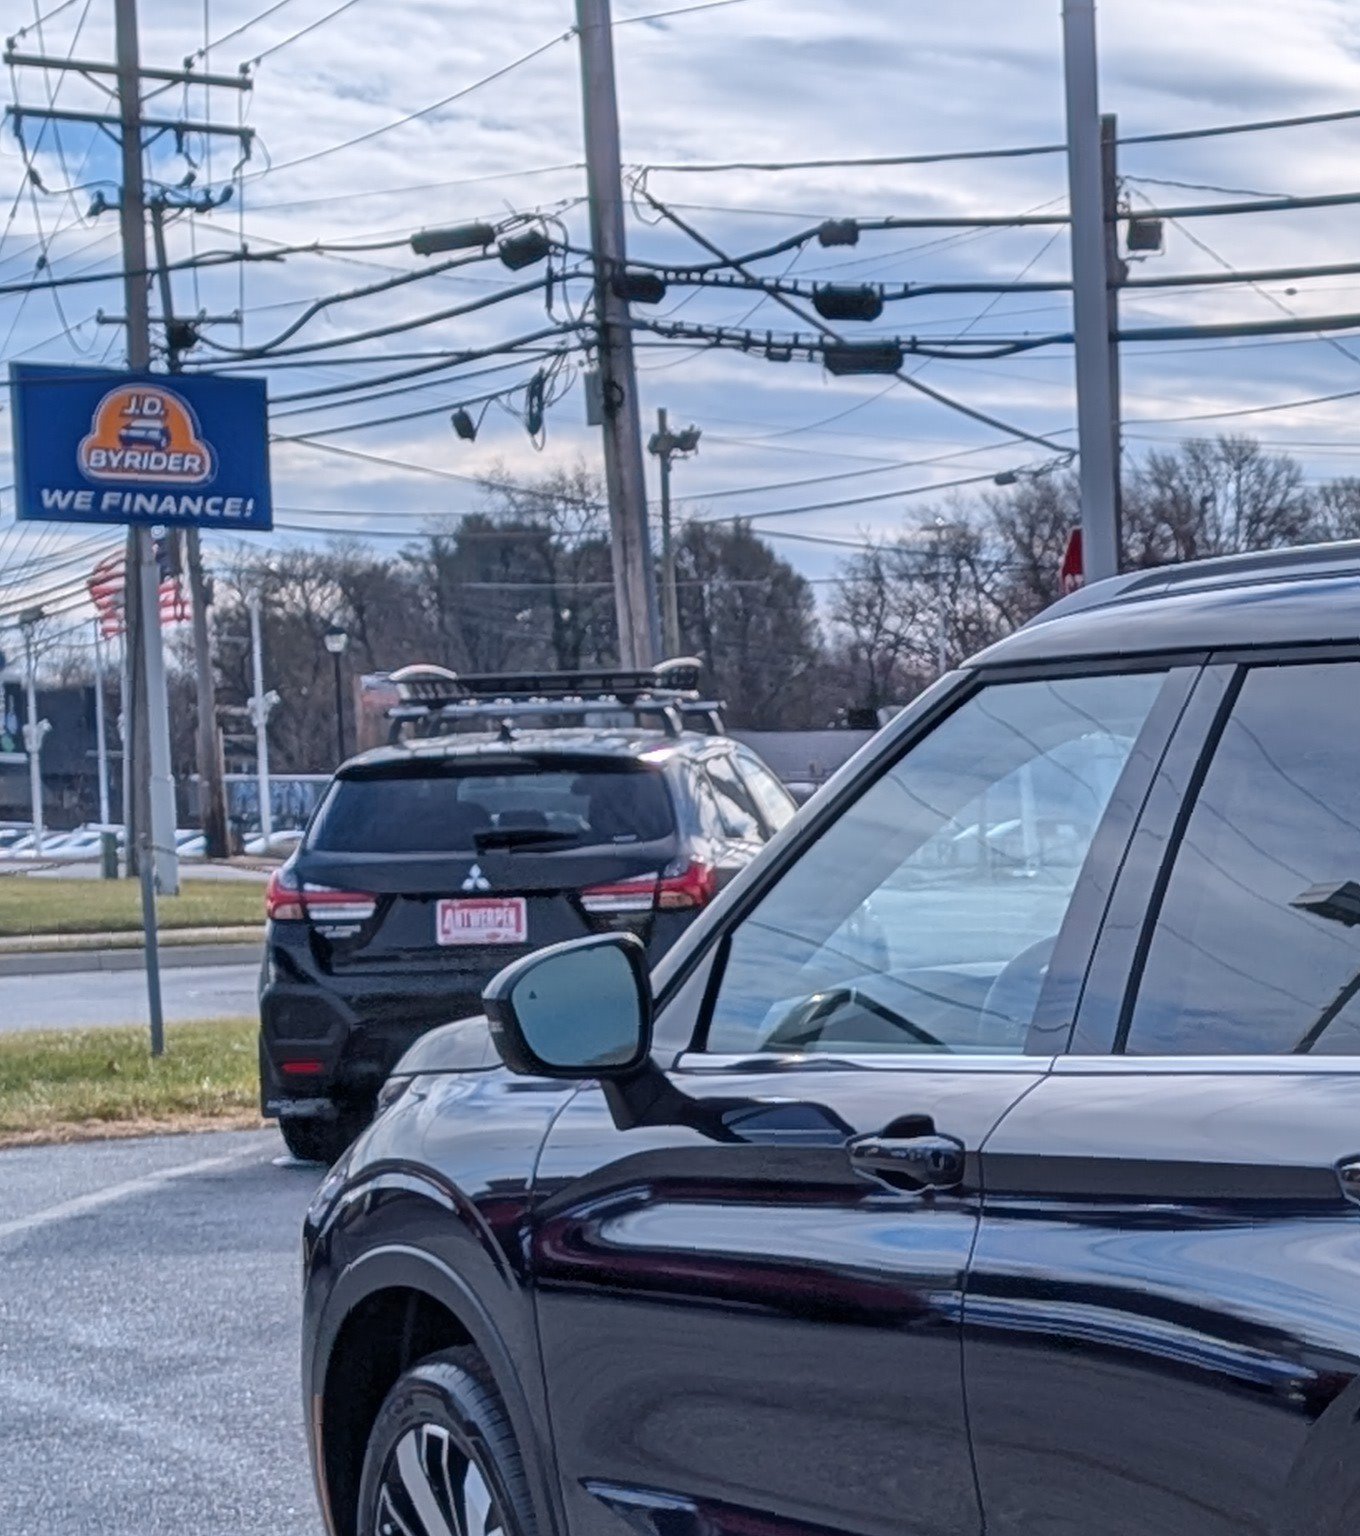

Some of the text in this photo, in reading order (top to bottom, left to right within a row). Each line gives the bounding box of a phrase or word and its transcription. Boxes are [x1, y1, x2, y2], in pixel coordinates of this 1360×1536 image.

[123, 395, 165, 416] J.D.
[89, 449, 203, 473] BYRIDER
[41, 488, 255, 518] WE FINANCE!
